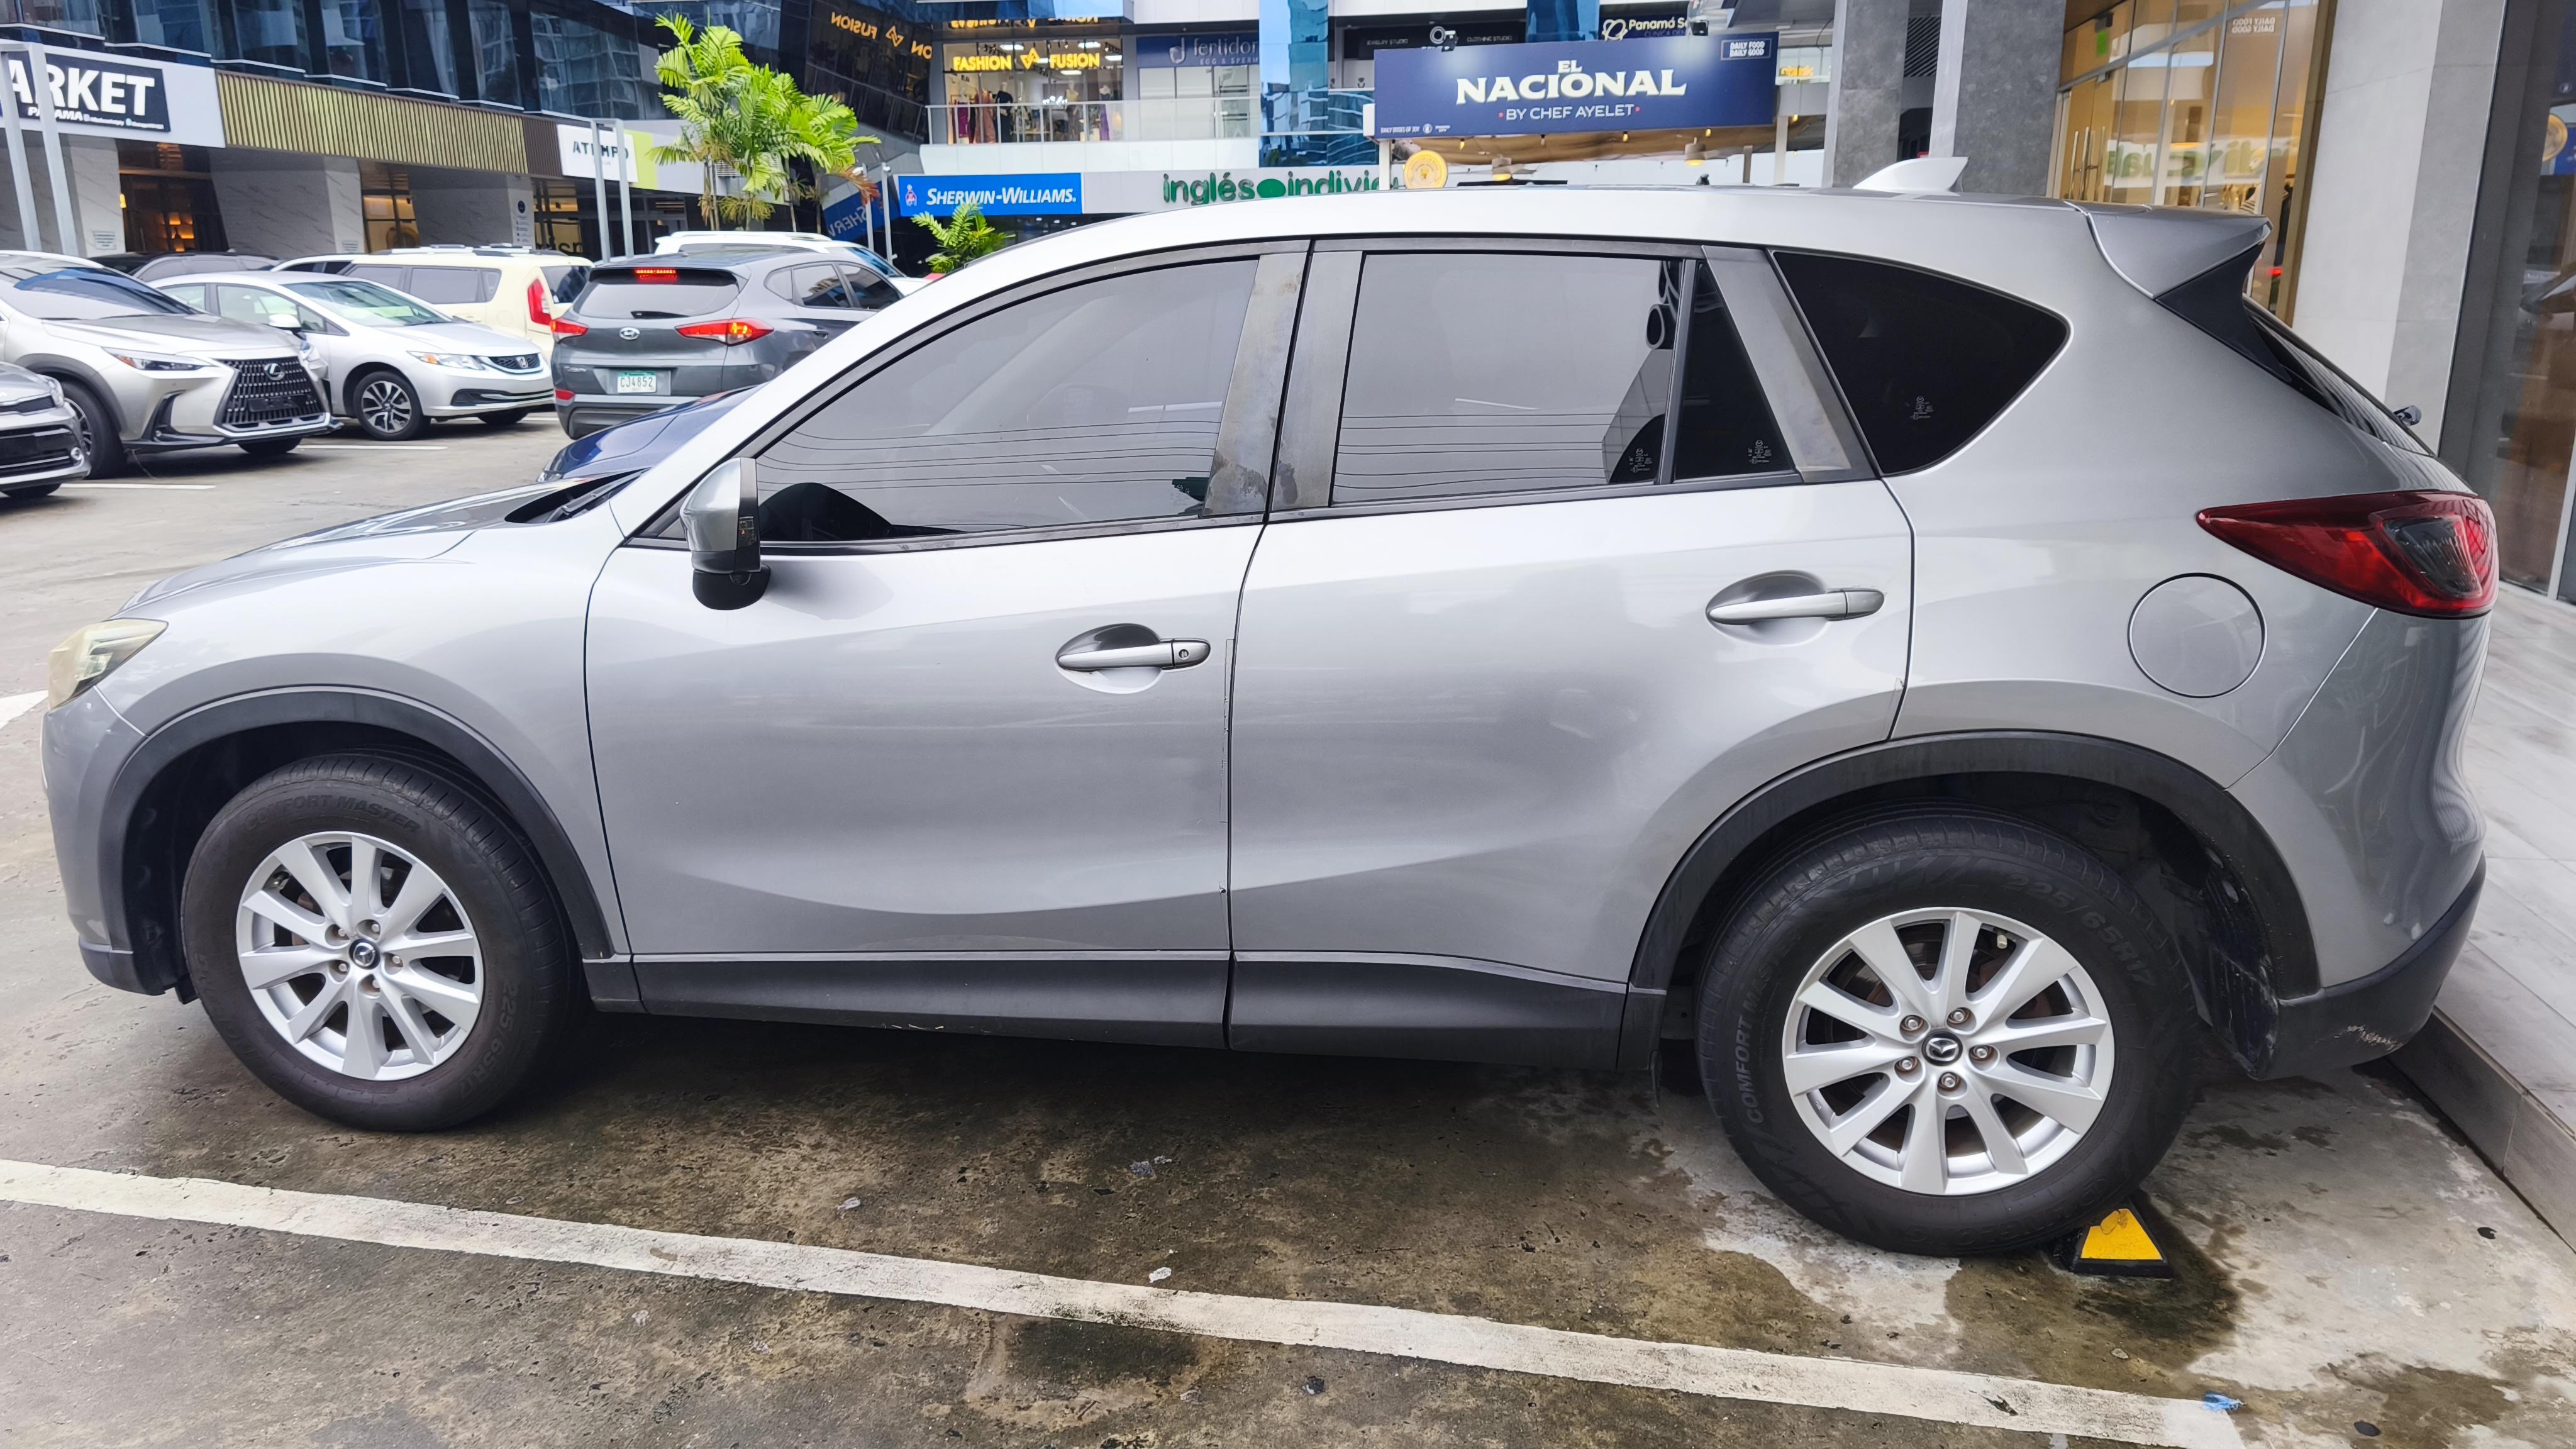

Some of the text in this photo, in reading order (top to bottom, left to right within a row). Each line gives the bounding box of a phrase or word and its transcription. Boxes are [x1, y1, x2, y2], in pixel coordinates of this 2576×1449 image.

[1629, 16, 1676, 30] Panamá
[1730, 42, 1748, 50] DAILY
[1730, 49, 1748, 57] DAILY
[953, 53, 1101, 71] FASHION FUSION
[1558, 60, 1583, 74] EL
[1456, 69, 1687, 105] NACIONAL
[28, 106, 83, 121] PAMA
[1506, 104, 1635, 120] BY CHEF AYELET
[1163, 172, 1255, 206] inglés
[336, 796, 422, 833] MASTER
[1735, 1014, 1764, 1124] COMFORT
